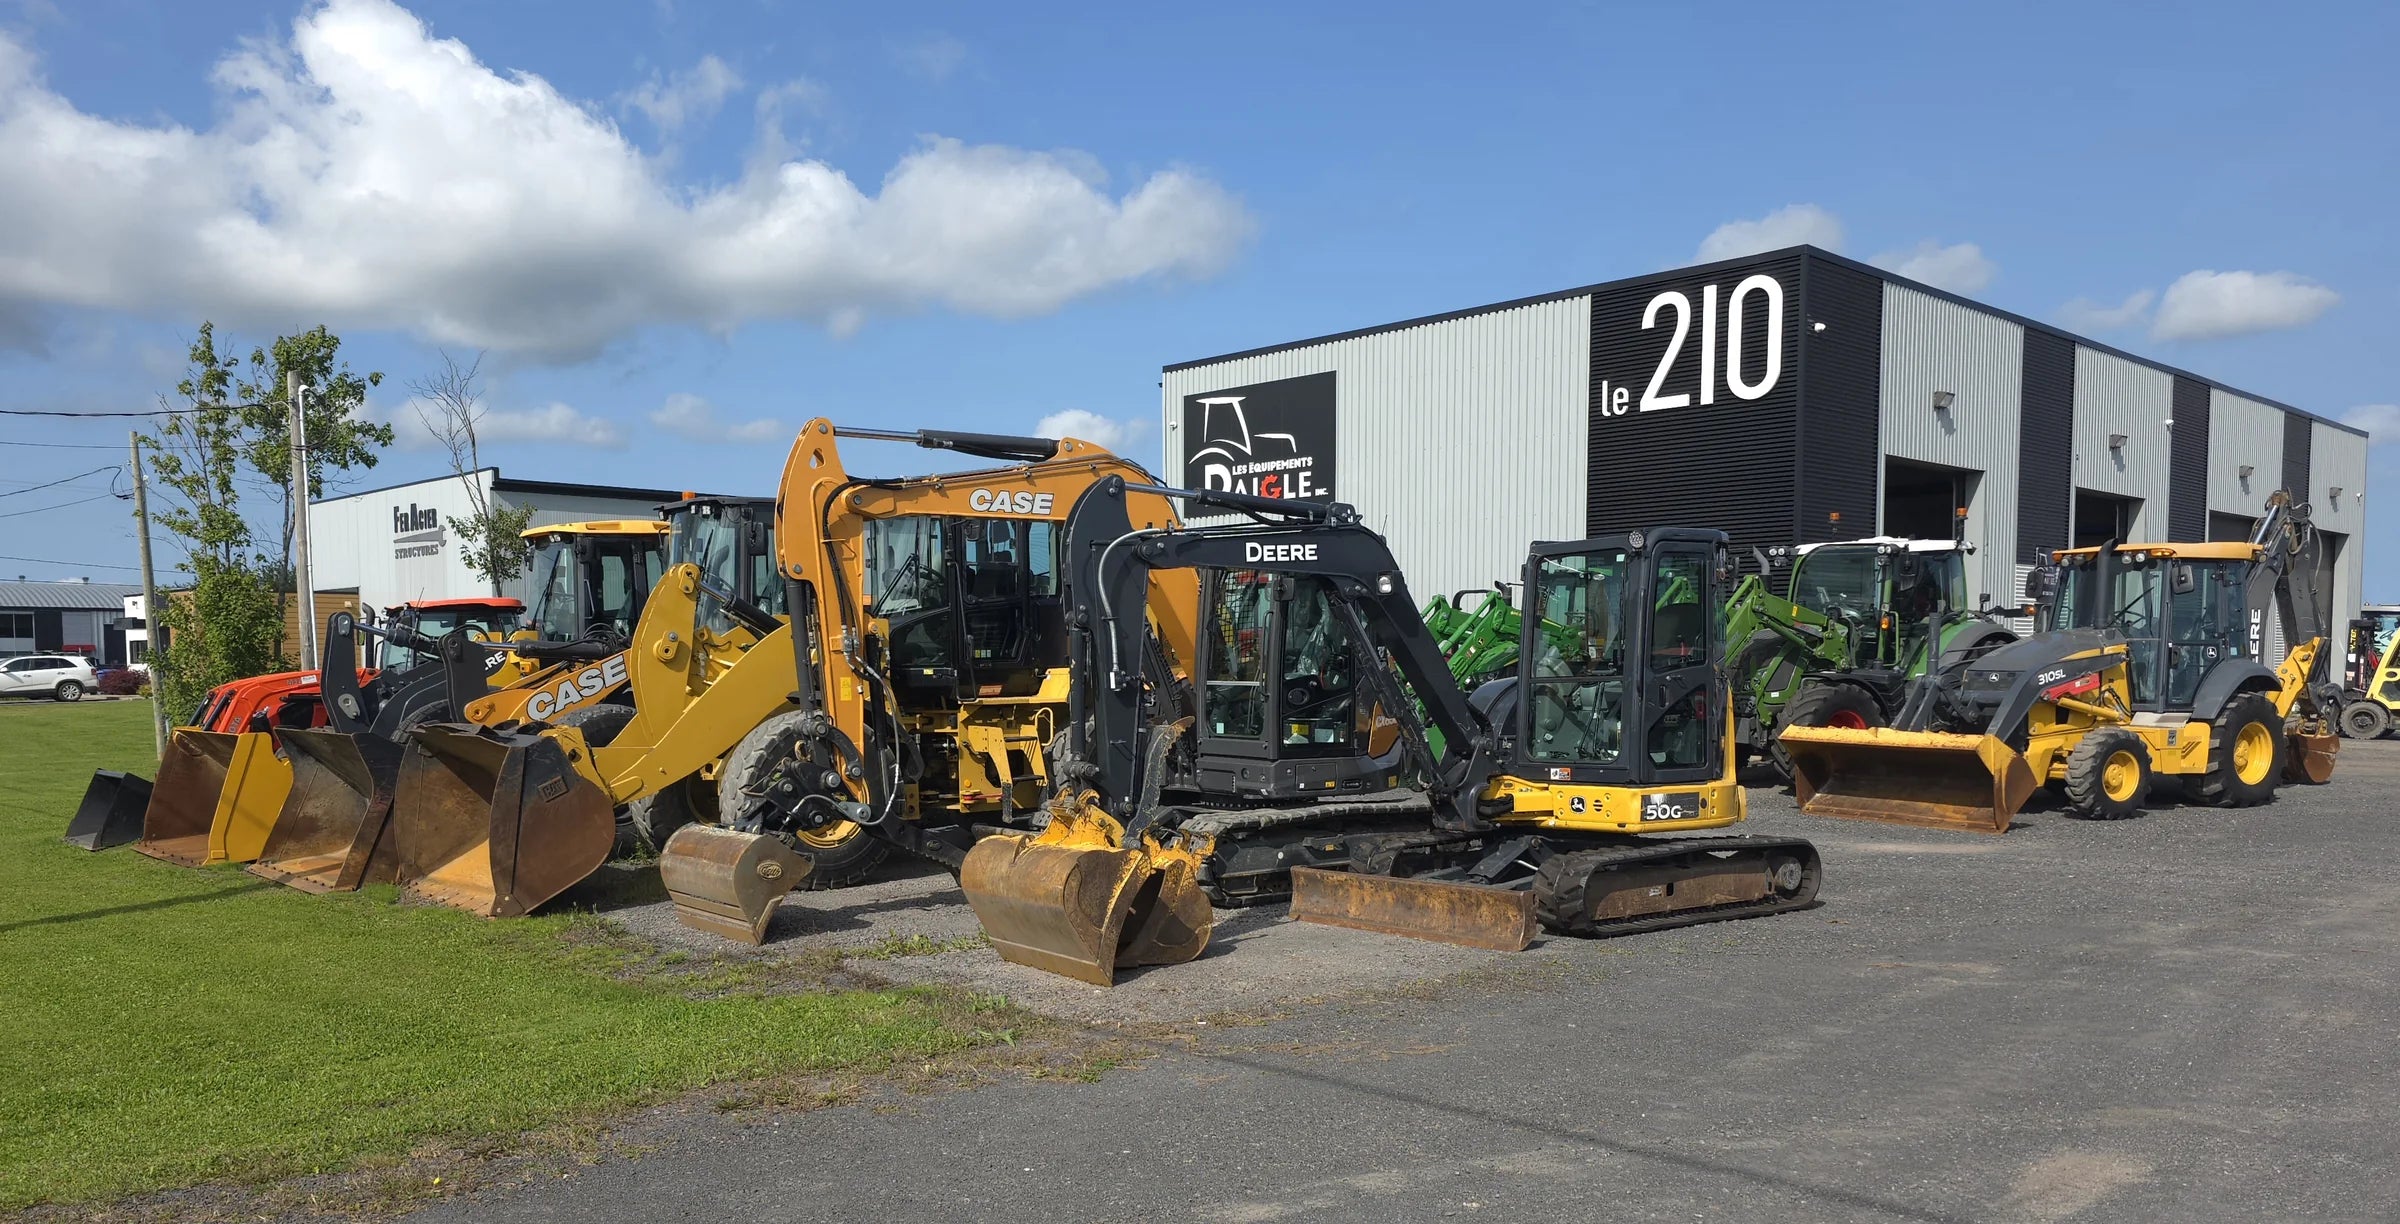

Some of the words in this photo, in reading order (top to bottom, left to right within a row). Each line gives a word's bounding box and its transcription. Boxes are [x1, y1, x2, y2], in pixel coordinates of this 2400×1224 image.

[1602, 380, 1629, 417] le
[1639, 274, 1784, 412] 210
[1232, 465, 1248, 476] LES
[1204, 463, 1312, 499] DAIGLE
[969, 488, 1054, 515] CASE
[395, 544, 438, 559] STRUCTURES
[1245, 542, 1318, 562] DEERE
[2038, 669, 2066, 685] 310SL
[526, 654, 628, 721] CASE
[1646, 803, 1682, 820] 50G
